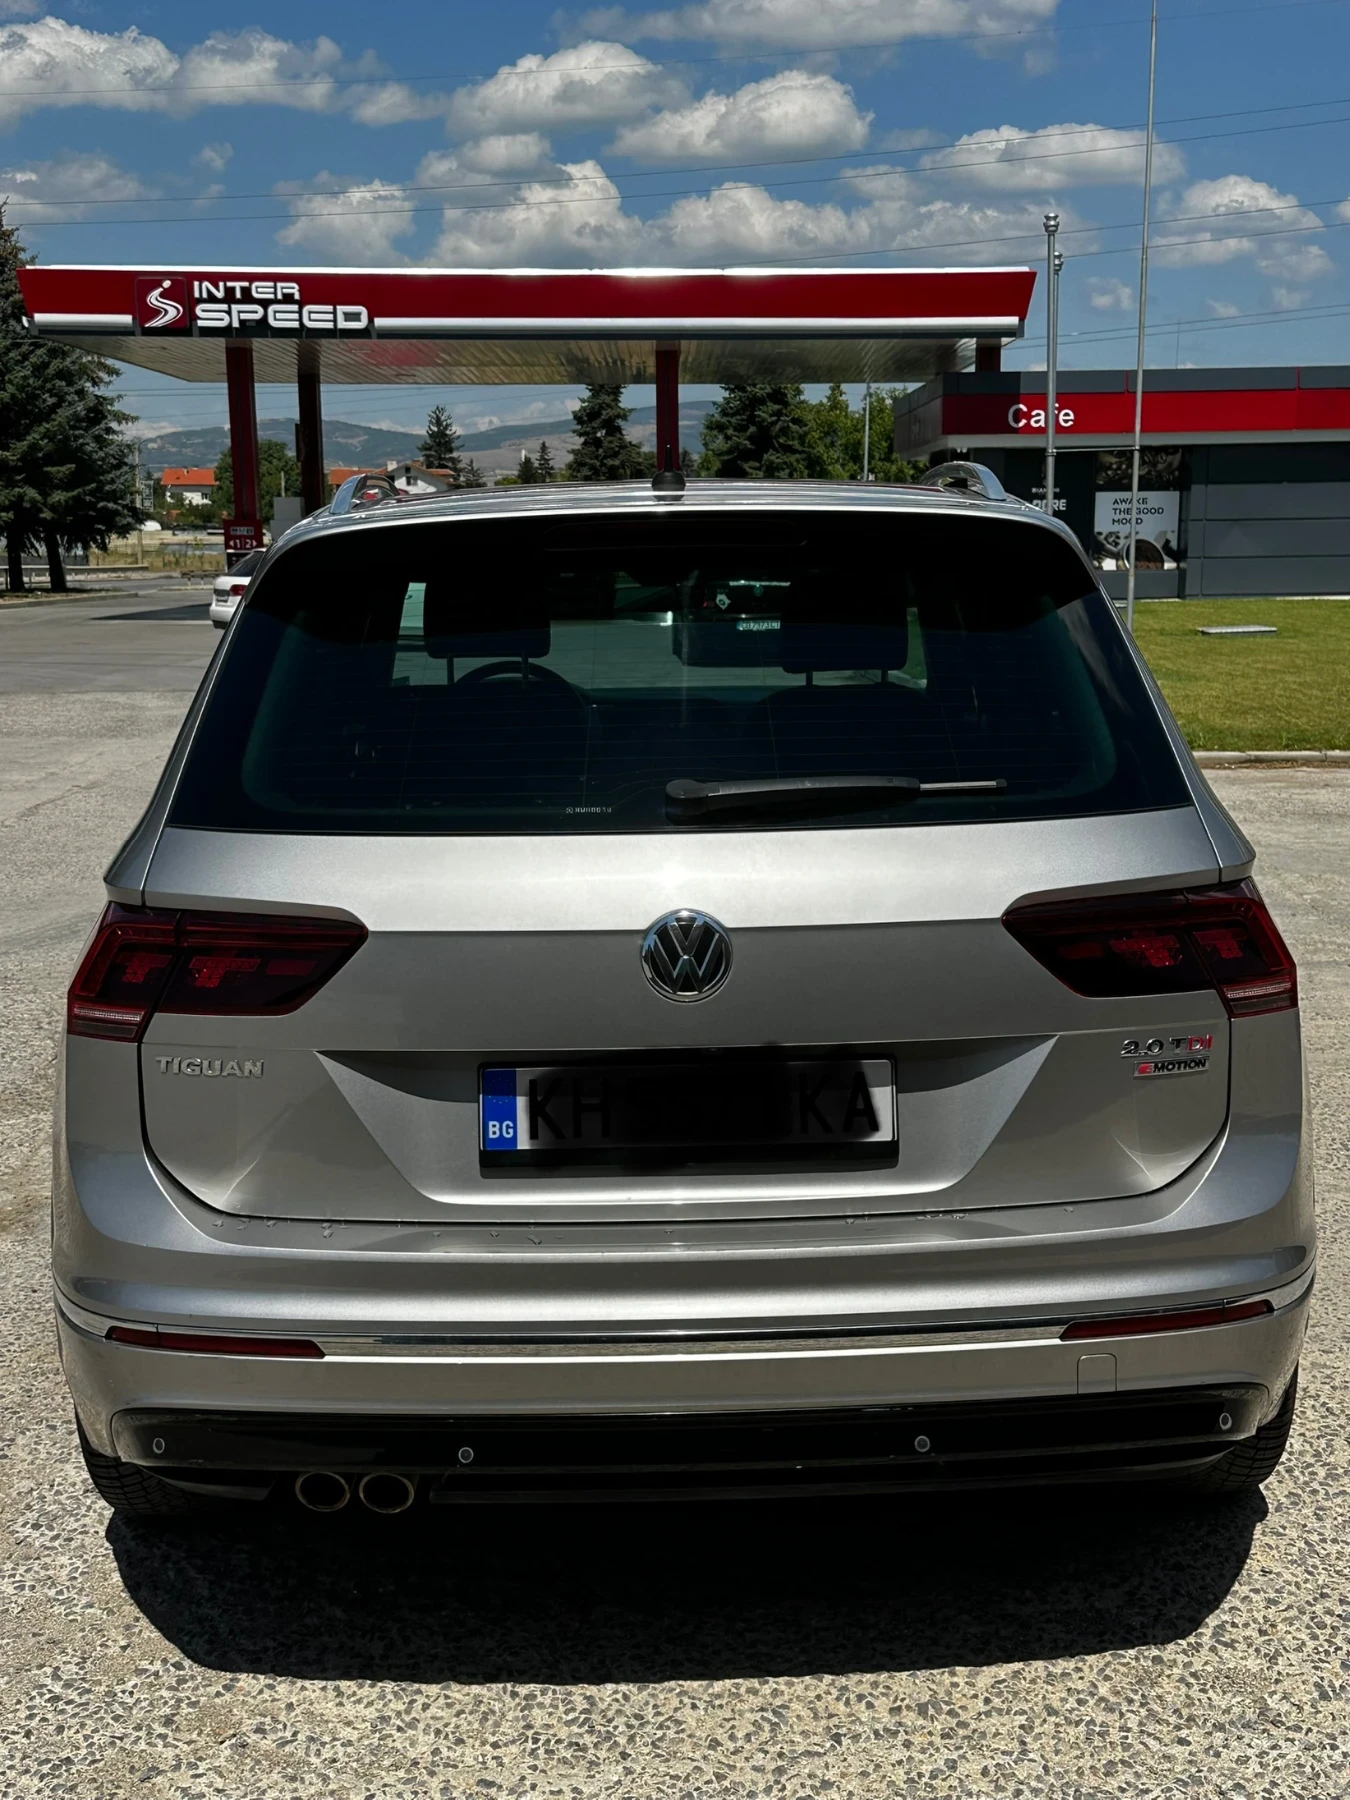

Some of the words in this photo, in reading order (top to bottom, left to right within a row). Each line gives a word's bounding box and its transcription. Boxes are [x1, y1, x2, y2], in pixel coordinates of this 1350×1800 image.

[193, 280, 300, 300] INTER
[195, 303, 369, 329] SPEED
[1112, 507, 1132, 516] THE
[235, 539, 241, 549] 1
[245, 539, 252, 549] 2
[1120, 1037, 1165, 1057] 2.0
[1169, 1033, 1213, 1054] TDI
[155, 1056, 264, 1078] TIGUAN
[487, 1120, 515, 1140] BG
